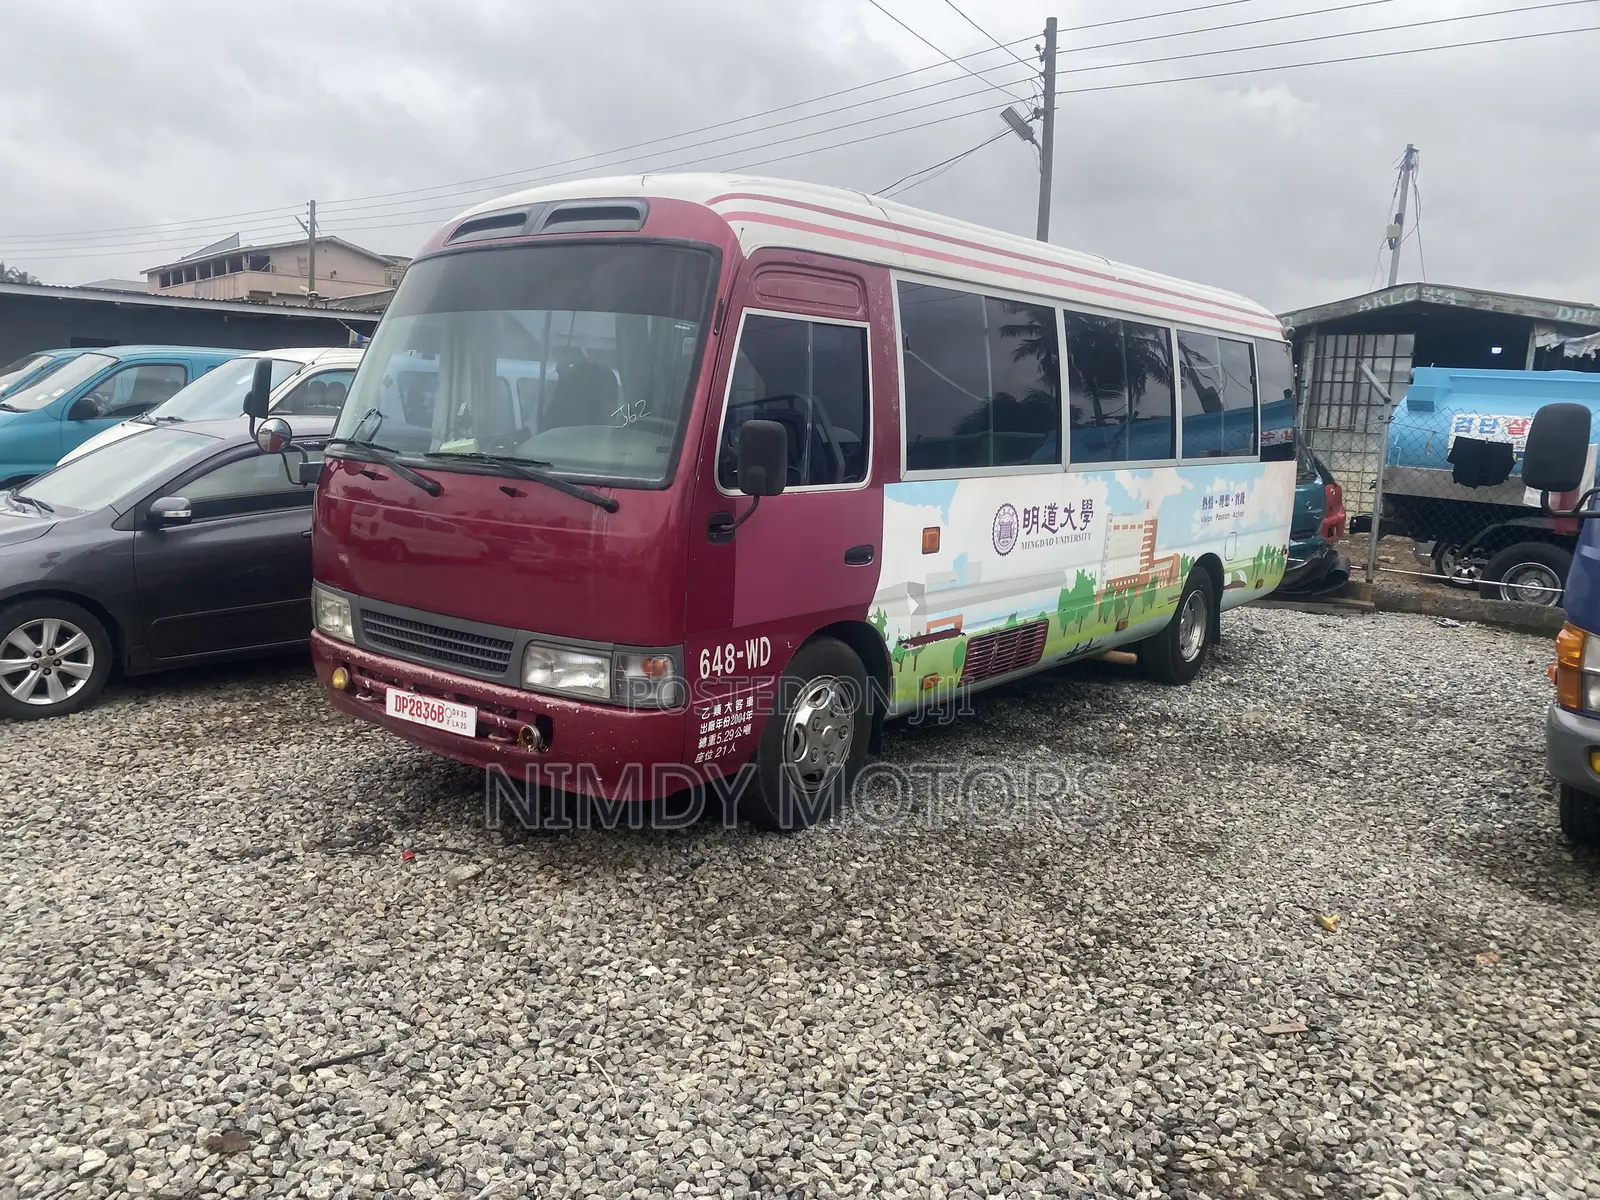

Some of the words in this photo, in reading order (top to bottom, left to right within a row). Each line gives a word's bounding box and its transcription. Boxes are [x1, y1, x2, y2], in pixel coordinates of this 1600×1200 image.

[1022, 499, 1094, 535] 明道大學
[1216, 513, 1230, 521] Passion
[1233, 510, 1245, 518] Action
[1021, 537, 1054, 550] MINGDAO
[1056, 532, 1092, 545] UNIVERSITY
[700, 636, 771, 679] 648-WD
[394, 694, 445, 723] DP2836B
